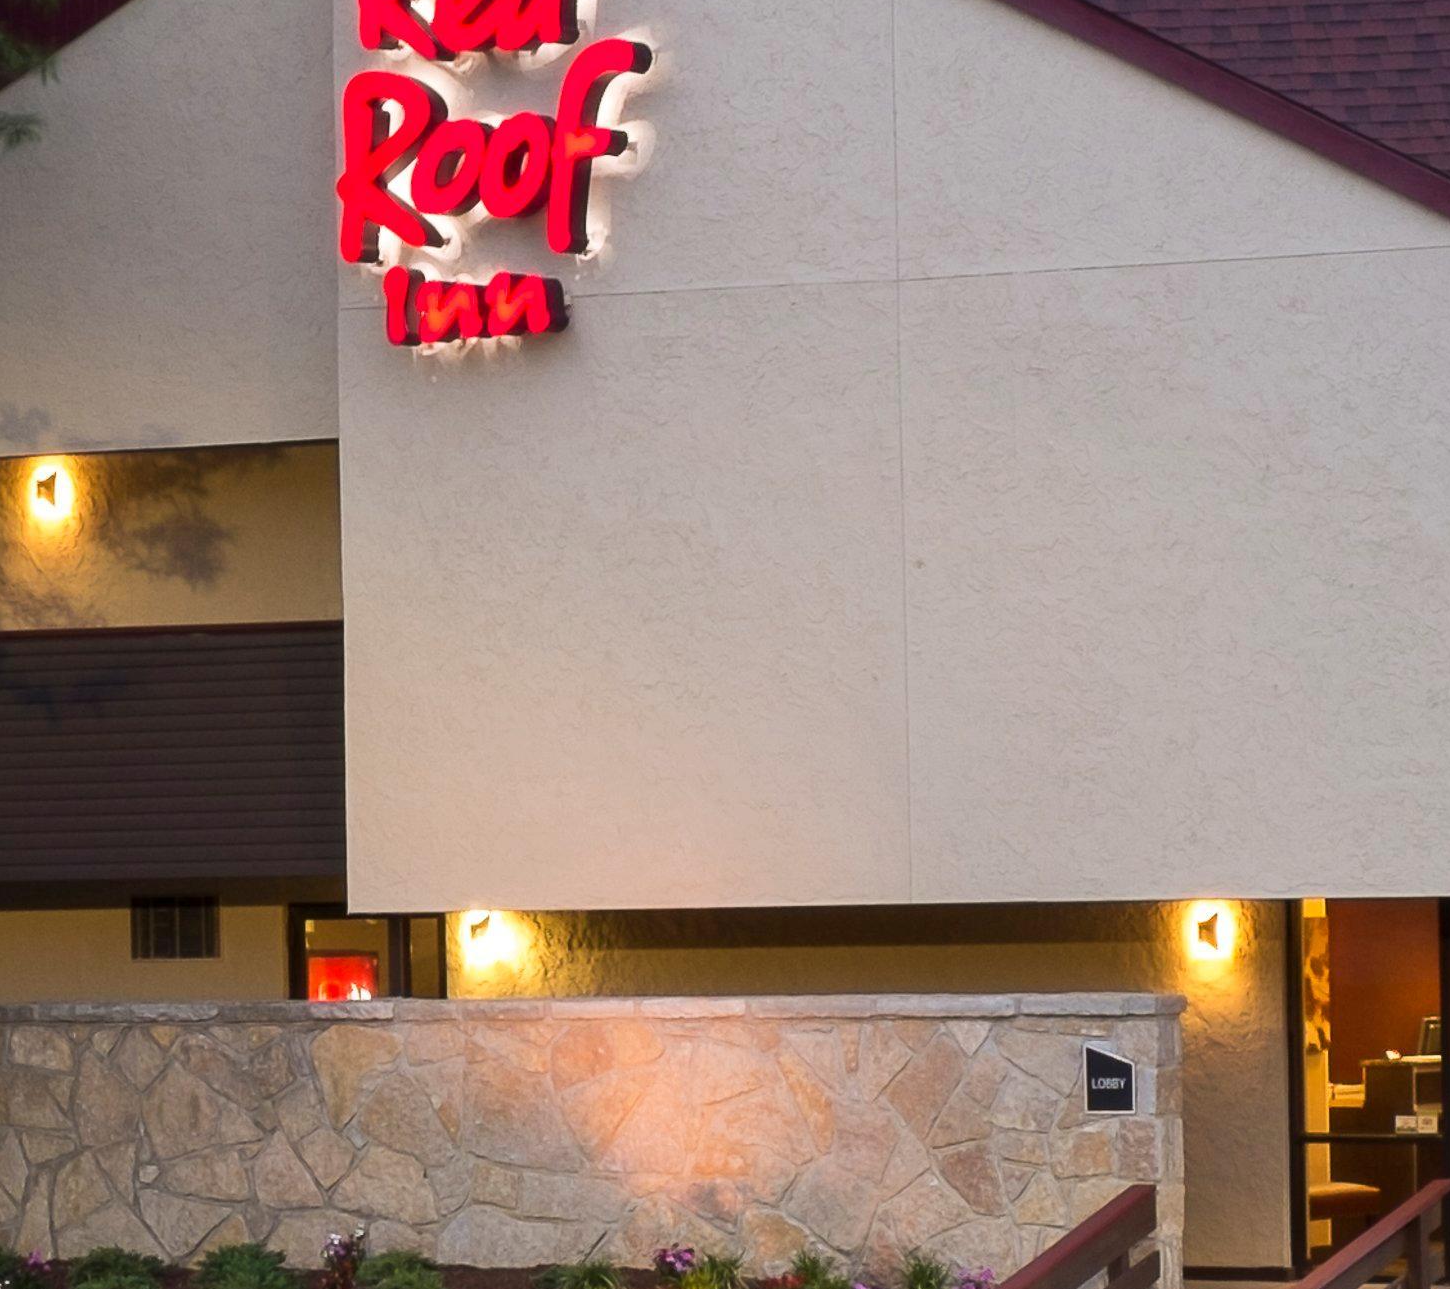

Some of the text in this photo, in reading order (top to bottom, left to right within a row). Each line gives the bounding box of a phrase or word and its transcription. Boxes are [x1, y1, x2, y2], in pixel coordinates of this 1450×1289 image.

[336, 38, 652, 263] Roof
[384, 265, 570, 347] Inn
[1091, 1077, 1127, 1090] LOBBY
